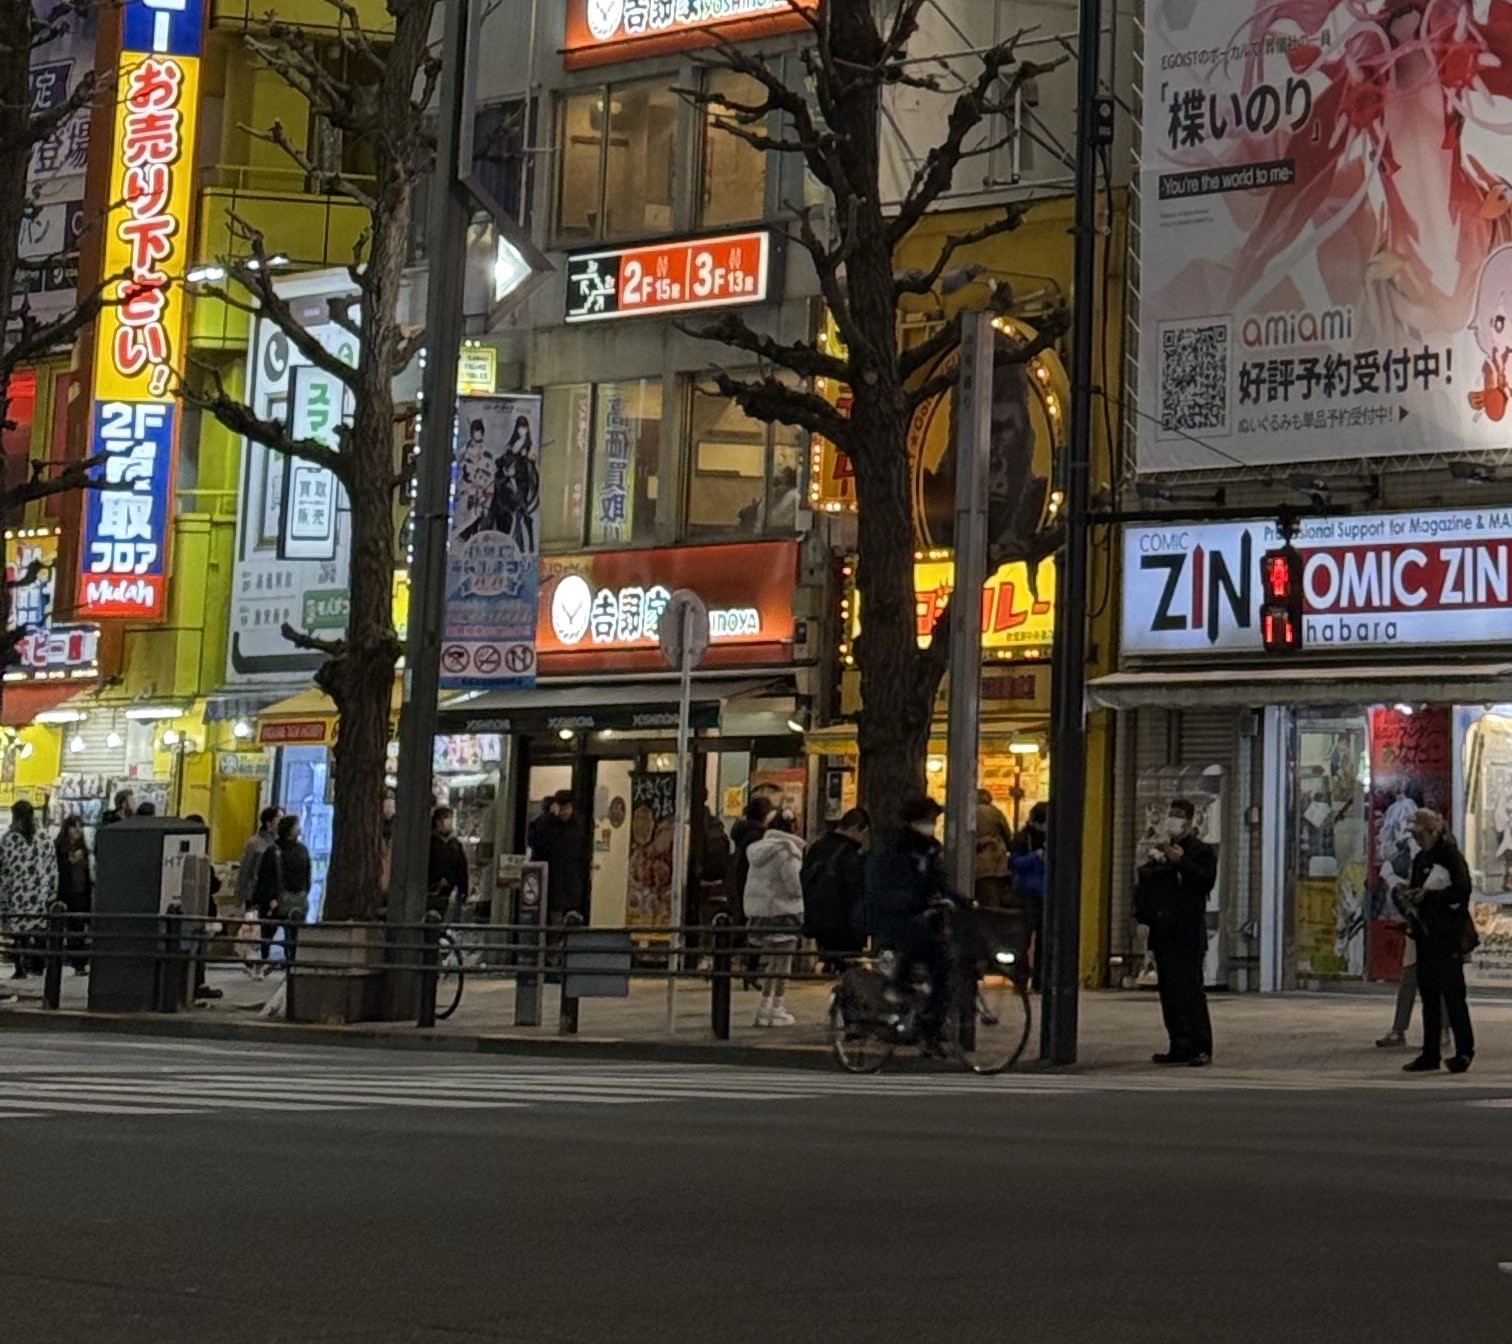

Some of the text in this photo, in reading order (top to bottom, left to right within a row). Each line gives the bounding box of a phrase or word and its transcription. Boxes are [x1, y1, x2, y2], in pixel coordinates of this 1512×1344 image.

[1201, 175, 1220, 191] the
[1222, 170, 1254, 188] world
[1256, 169, 1268, 184] to
[1242, 310, 1354, 349] amiami
[1238, 348, 1454, 407] 好評予約受付中!
[101, 403, 166, 440] 2F
[1140, 531, 1190, 553] COMIC
[1337, 516, 1386, 540] Support
[1389, 517, 1406, 536] for
[1408, 512, 1472, 537] Magazine
[91, 542, 157, 575] フロア
[1302, 544, 1509, 610] OMIC ZIN
[1140, 528, 1253, 646] ZIN
